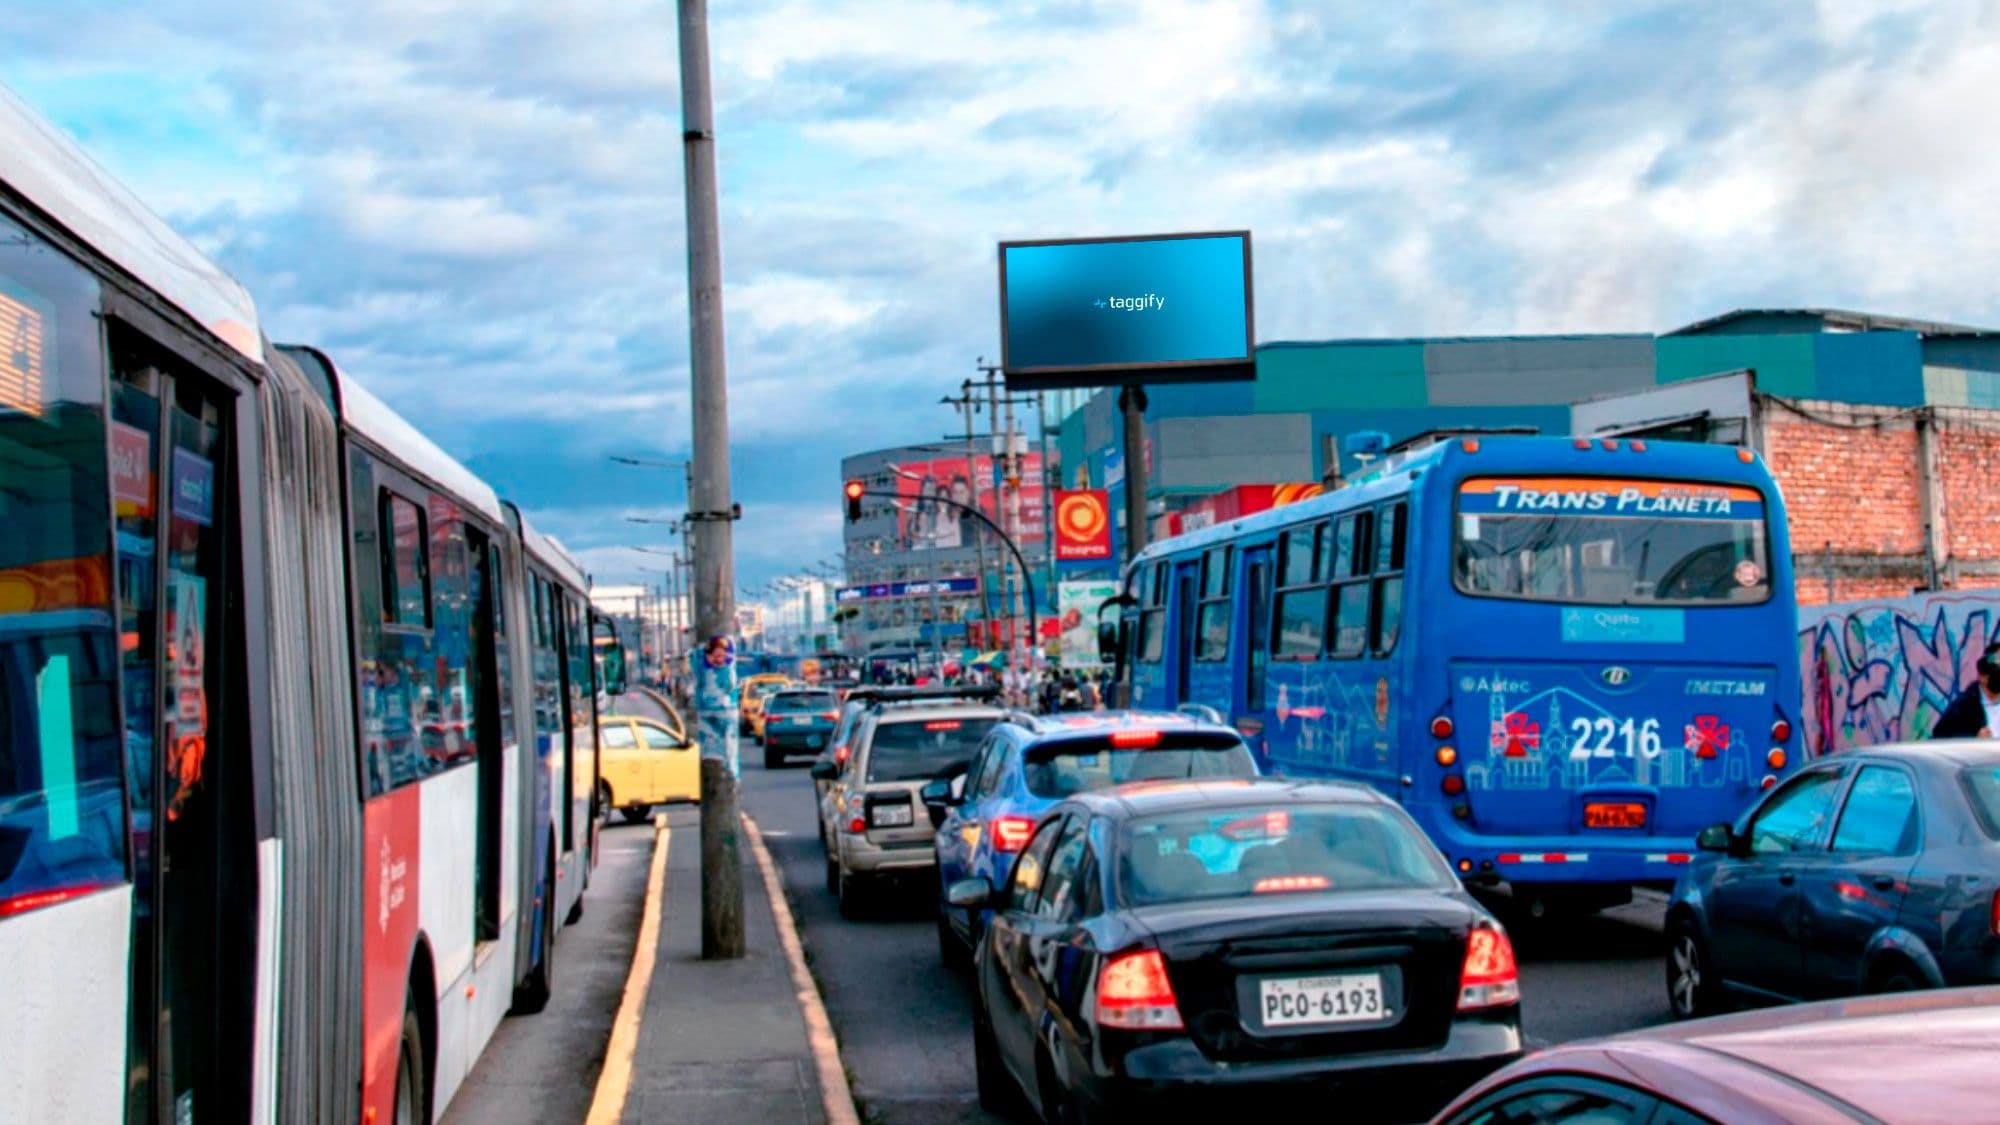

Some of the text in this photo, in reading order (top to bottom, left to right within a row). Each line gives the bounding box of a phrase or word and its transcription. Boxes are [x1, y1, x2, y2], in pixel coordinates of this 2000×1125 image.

[1109, 293, 1165, 311] taggify
[1493, 484, 1606, 510] TRANS
[1616, 487, 1731, 514] PLANETA
[1569, 716, 1661, 759] 2216
[1265, 988, 1379, 1020] PCO-6193
